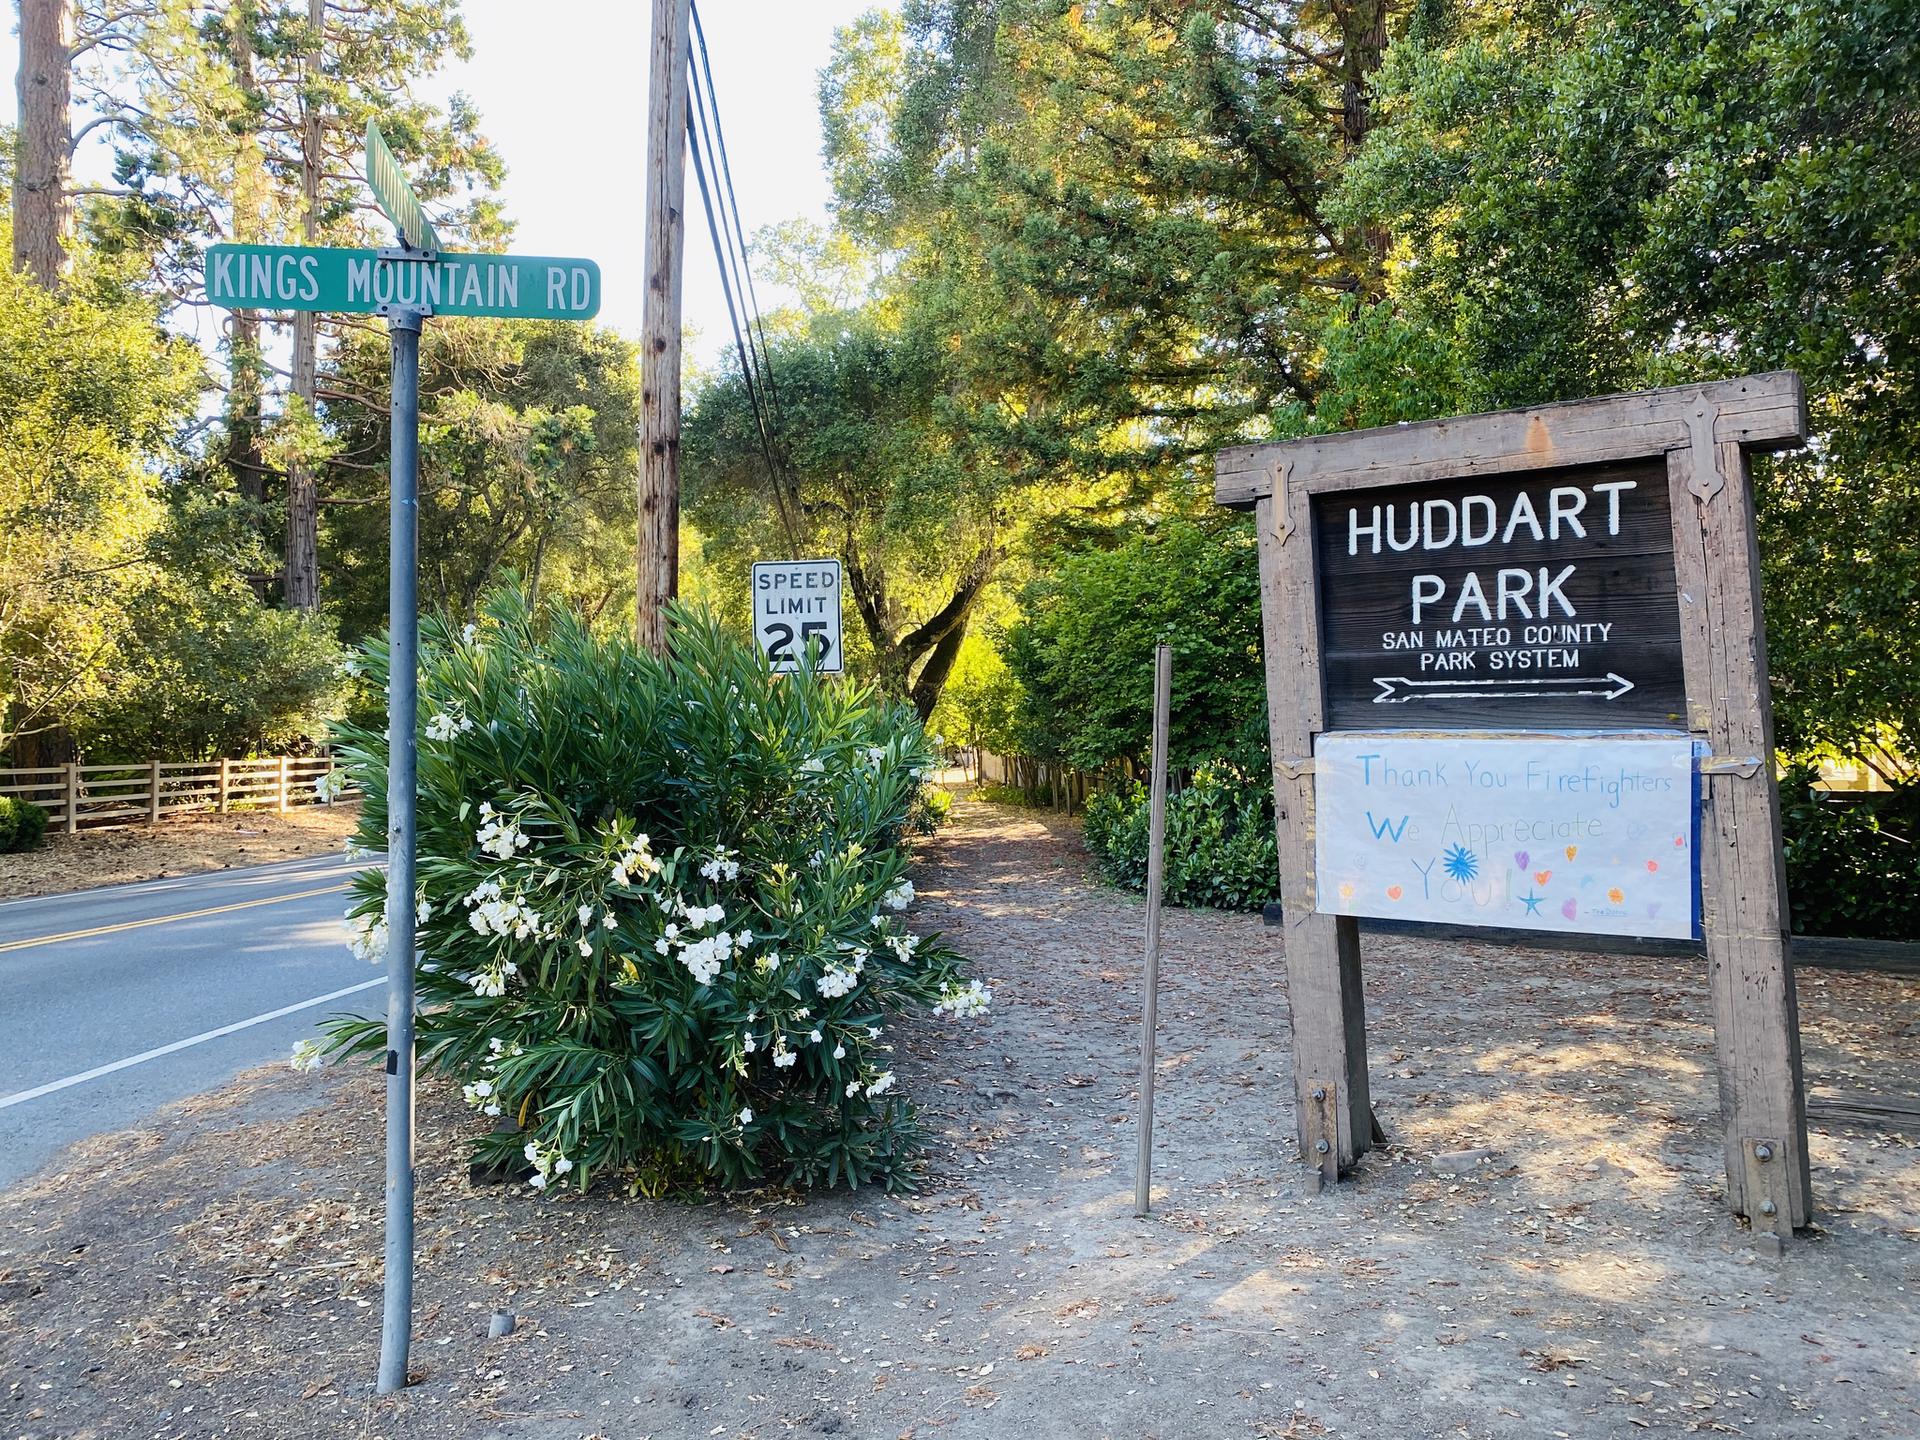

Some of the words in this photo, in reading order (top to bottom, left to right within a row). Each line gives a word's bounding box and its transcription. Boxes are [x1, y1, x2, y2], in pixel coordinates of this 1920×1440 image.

[214, 253, 319, 301] KINGS
[347, 258, 518, 307] MOUNTAIN
[547, 266, 591, 310] RD
[1348, 480, 1637, 555] HUDDART
[759, 572, 834, 590] SPEED
[1412, 564, 1576, 624] PARK
[766, 597, 827, 614] LIMIT
[764, 621, 831, 663] 25
[1383, 630, 1423, 650] SAN
[1436, 628, 1510, 647] MATEO
[1524, 622, 1613, 645] COUNTY
[1420, 651, 1476, 671] PARK
[1489, 649, 1579, 670] SYSTEM
[1355, 754, 1448, 787] Thank
[1464, 760, 1507, 788] You
[1527, 760, 1672, 808] Firefighters
[1366, 811, 1420, 842] We
[1440, 802, 1602, 860] Appreciate
